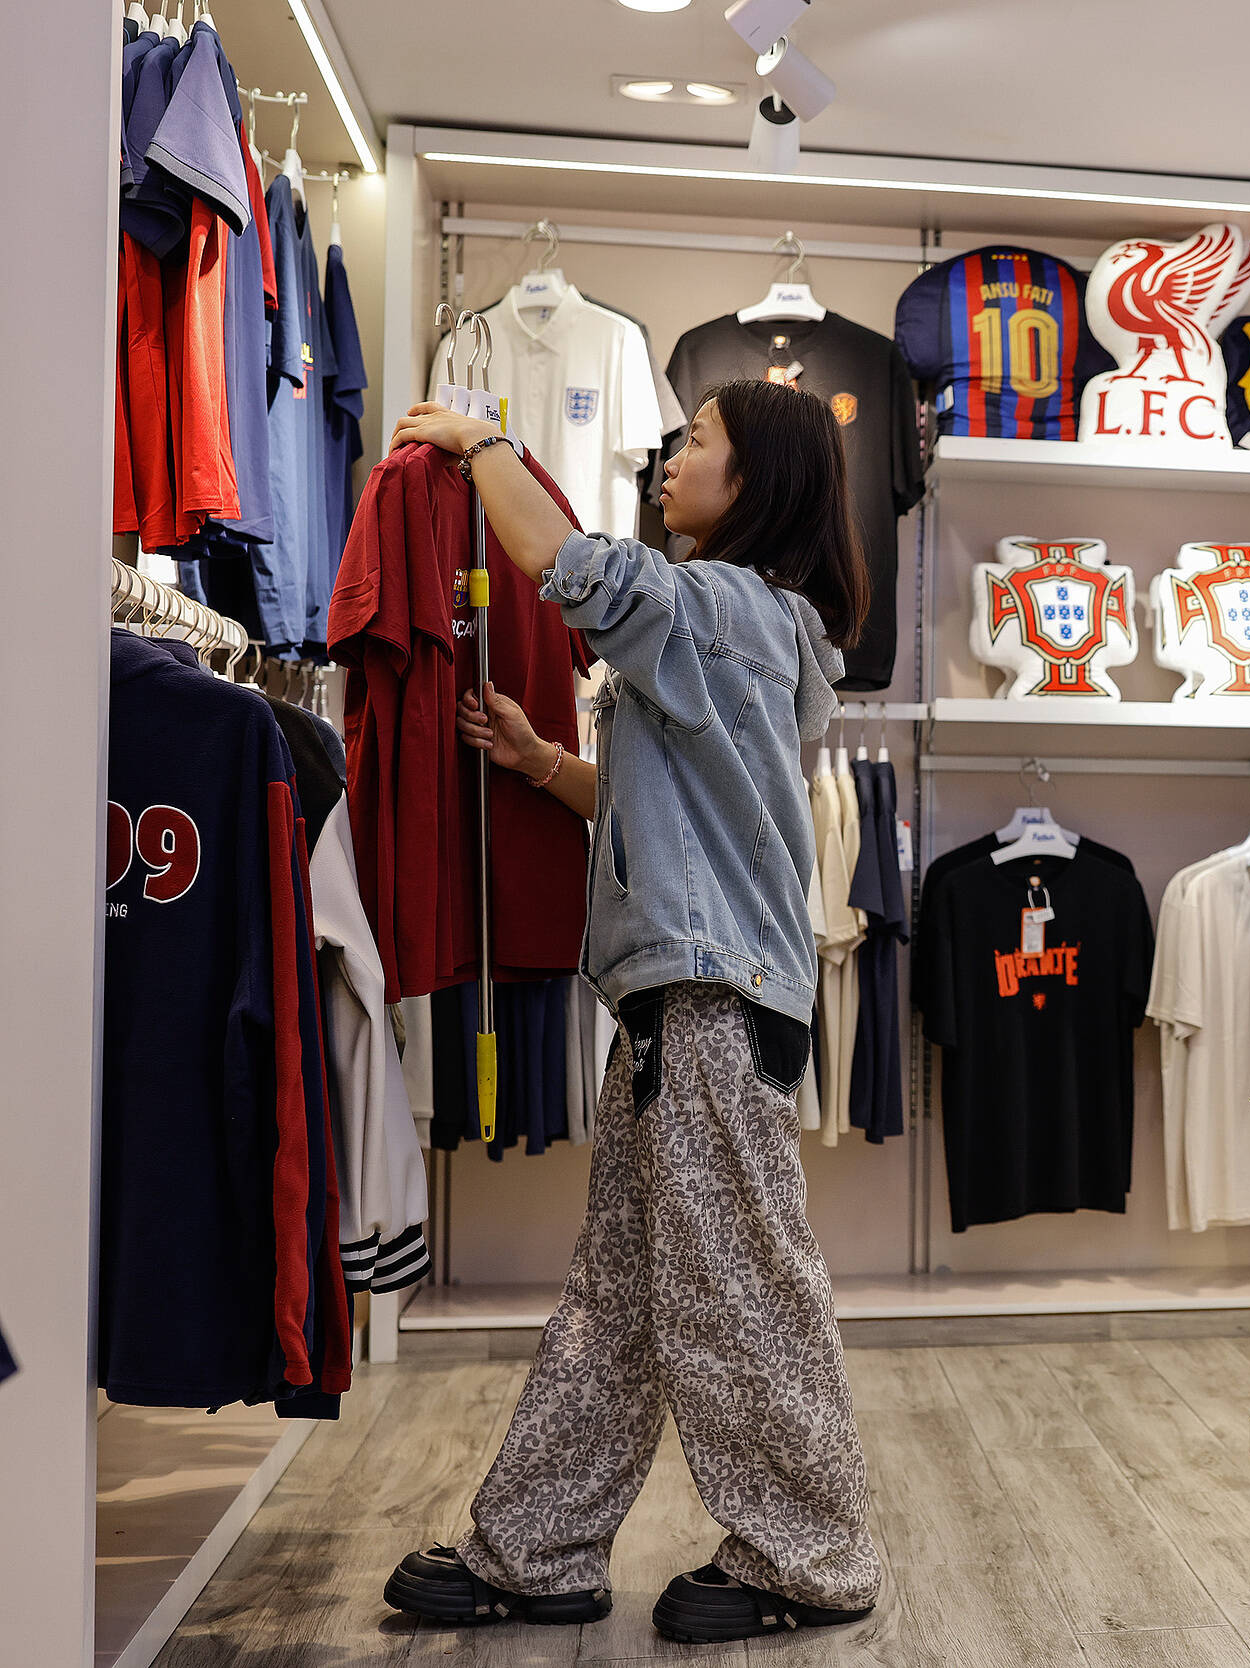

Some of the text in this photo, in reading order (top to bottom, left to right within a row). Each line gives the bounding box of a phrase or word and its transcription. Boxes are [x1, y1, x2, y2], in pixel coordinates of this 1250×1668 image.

[980, 282, 1054, 306] ANSU FATI
[972, 307, 1059, 399] 10
